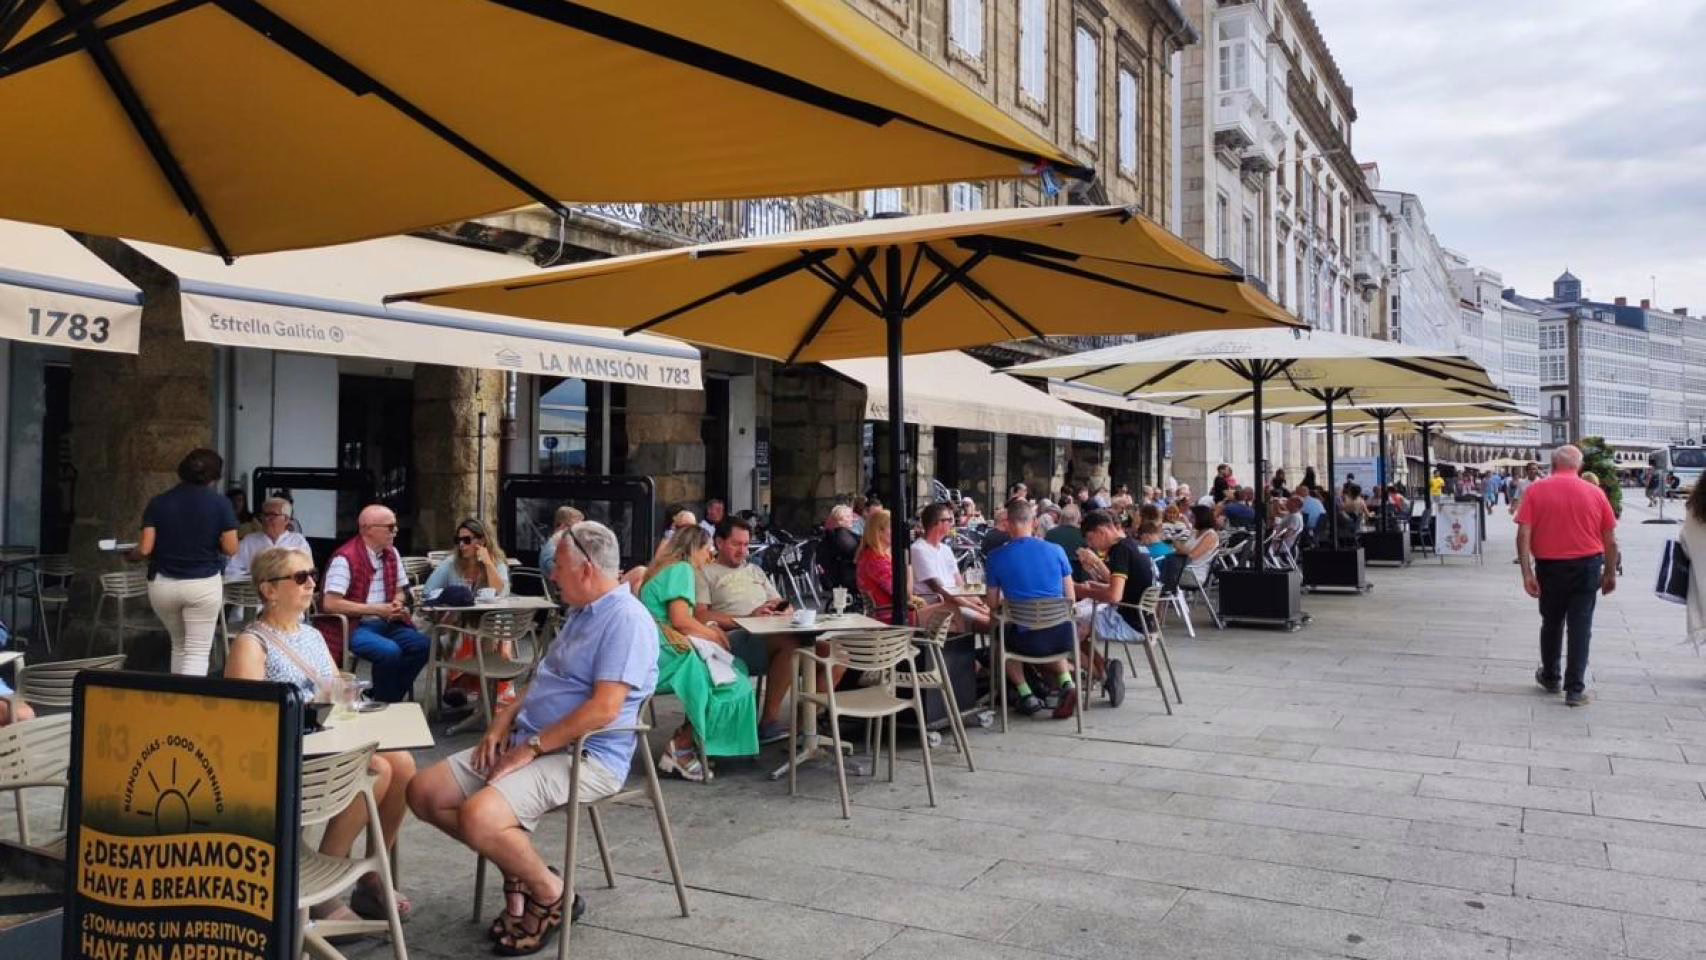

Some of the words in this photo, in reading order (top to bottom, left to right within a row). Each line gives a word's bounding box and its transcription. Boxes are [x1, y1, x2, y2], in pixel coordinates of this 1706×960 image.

[28, 307, 111, 344] 1783
[209, 312, 271, 335] Estrella
[273, 321, 326, 340] Galicia
[539, 351, 562, 371] LA
[568, 354, 649, 380] MANSIÓN
[659, 366, 691, 384] 1783
[167, 735, 195, 752] GOOD
[195, 748, 224, 814] MORNING
[84, 839, 270, 877] ¿DESAYUNAMOS?
[83, 868, 128, 899] HAVE
[133, 881, 146, 900] A
[152, 875, 269, 910] BREAKFAST?
[82, 912, 156, 939] ¿TOMAMOS
[160, 921, 180, 938] UN
[184, 920, 267, 951] APERITIVO?
[82, 932, 128, 960] HAVE
[135, 943, 163, 960] AN
[170, 943, 265, 960] APERITI
